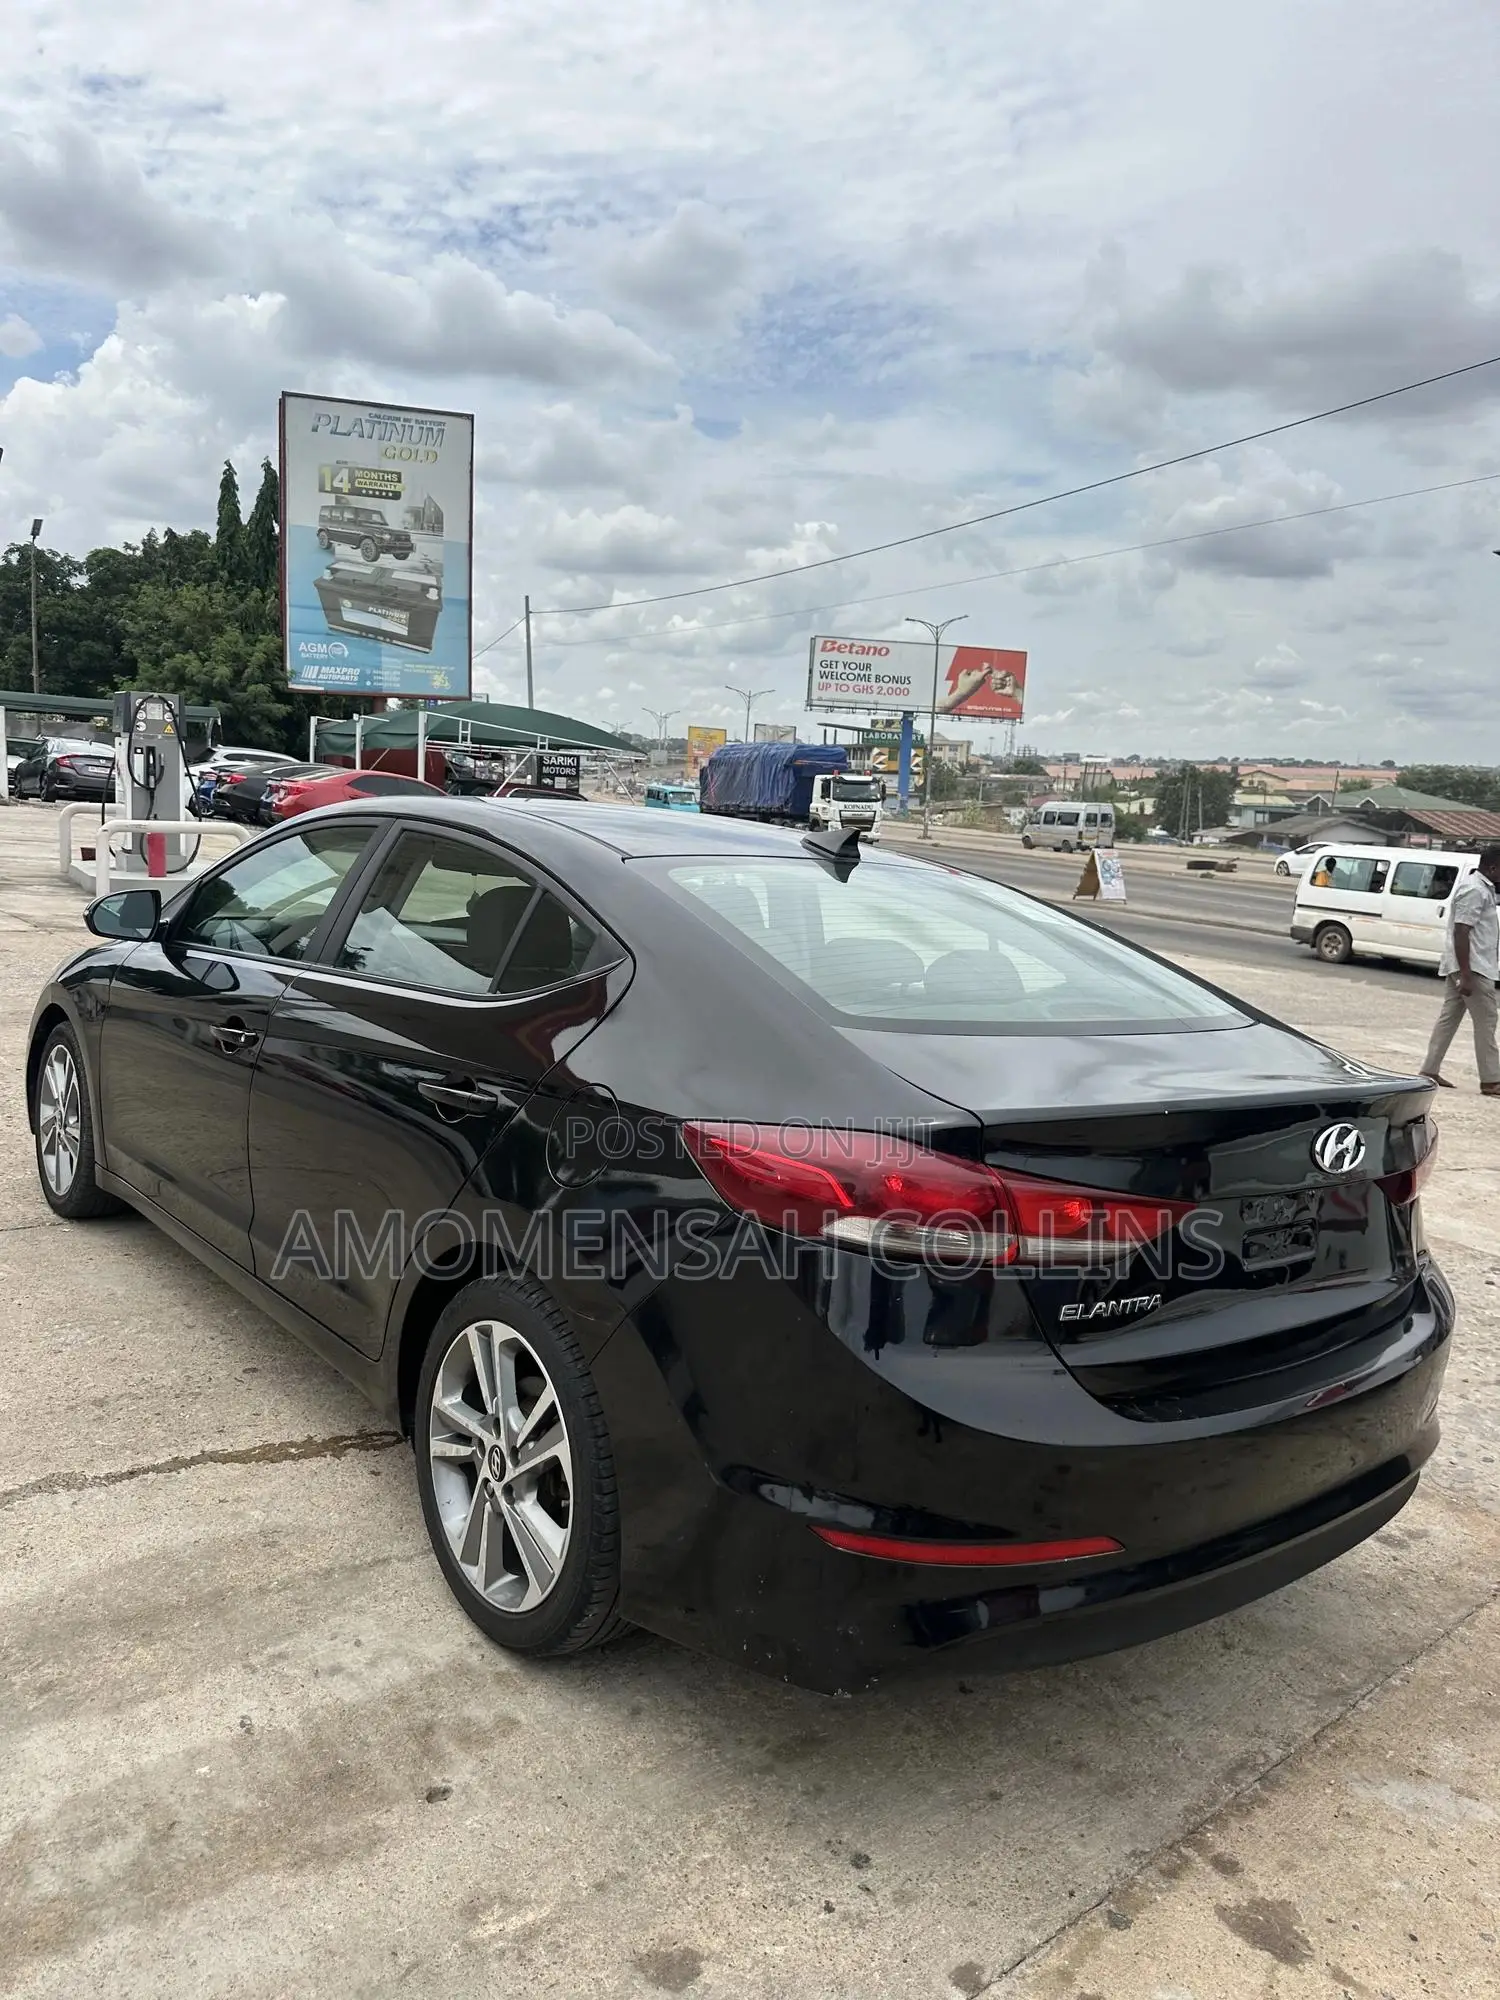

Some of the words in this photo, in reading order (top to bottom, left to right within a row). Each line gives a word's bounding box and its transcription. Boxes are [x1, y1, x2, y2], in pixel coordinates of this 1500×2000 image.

[311, 412, 445, 448] PLATINUM
[384, 445, 438, 464] GOLD
[320, 466, 351, 493] 14
[355, 469, 398, 482] MONTHS
[357, 479, 398, 490] WARRANTY
[368, 606, 407, 619] PLATINUM
[298, 641, 327, 653] AGM
[820, 639, 890, 657] Betano
[301, 652, 329, 660] BATTERY
[320, 666, 360, 676] MAXPRO
[819, 659, 839, 670] GET
[842, 661, 872, 672] YOUR
[318, 674, 359, 682] AUTOPARTS
[819, 670, 872, 683] WELCOME
[875, 674, 912, 685] BONUS
[818, 682, 832, 691] UP
[835, 683, 850, 693] TO
[852, 684, 873, 694] GHS
[863, 732, 922, 742] LABORATRY
[542, 756, 577, 766] SARIKI
[542, 766, 577, 776] MOTORS
[1059, 1293, 1163, 1322] ELANTRA
